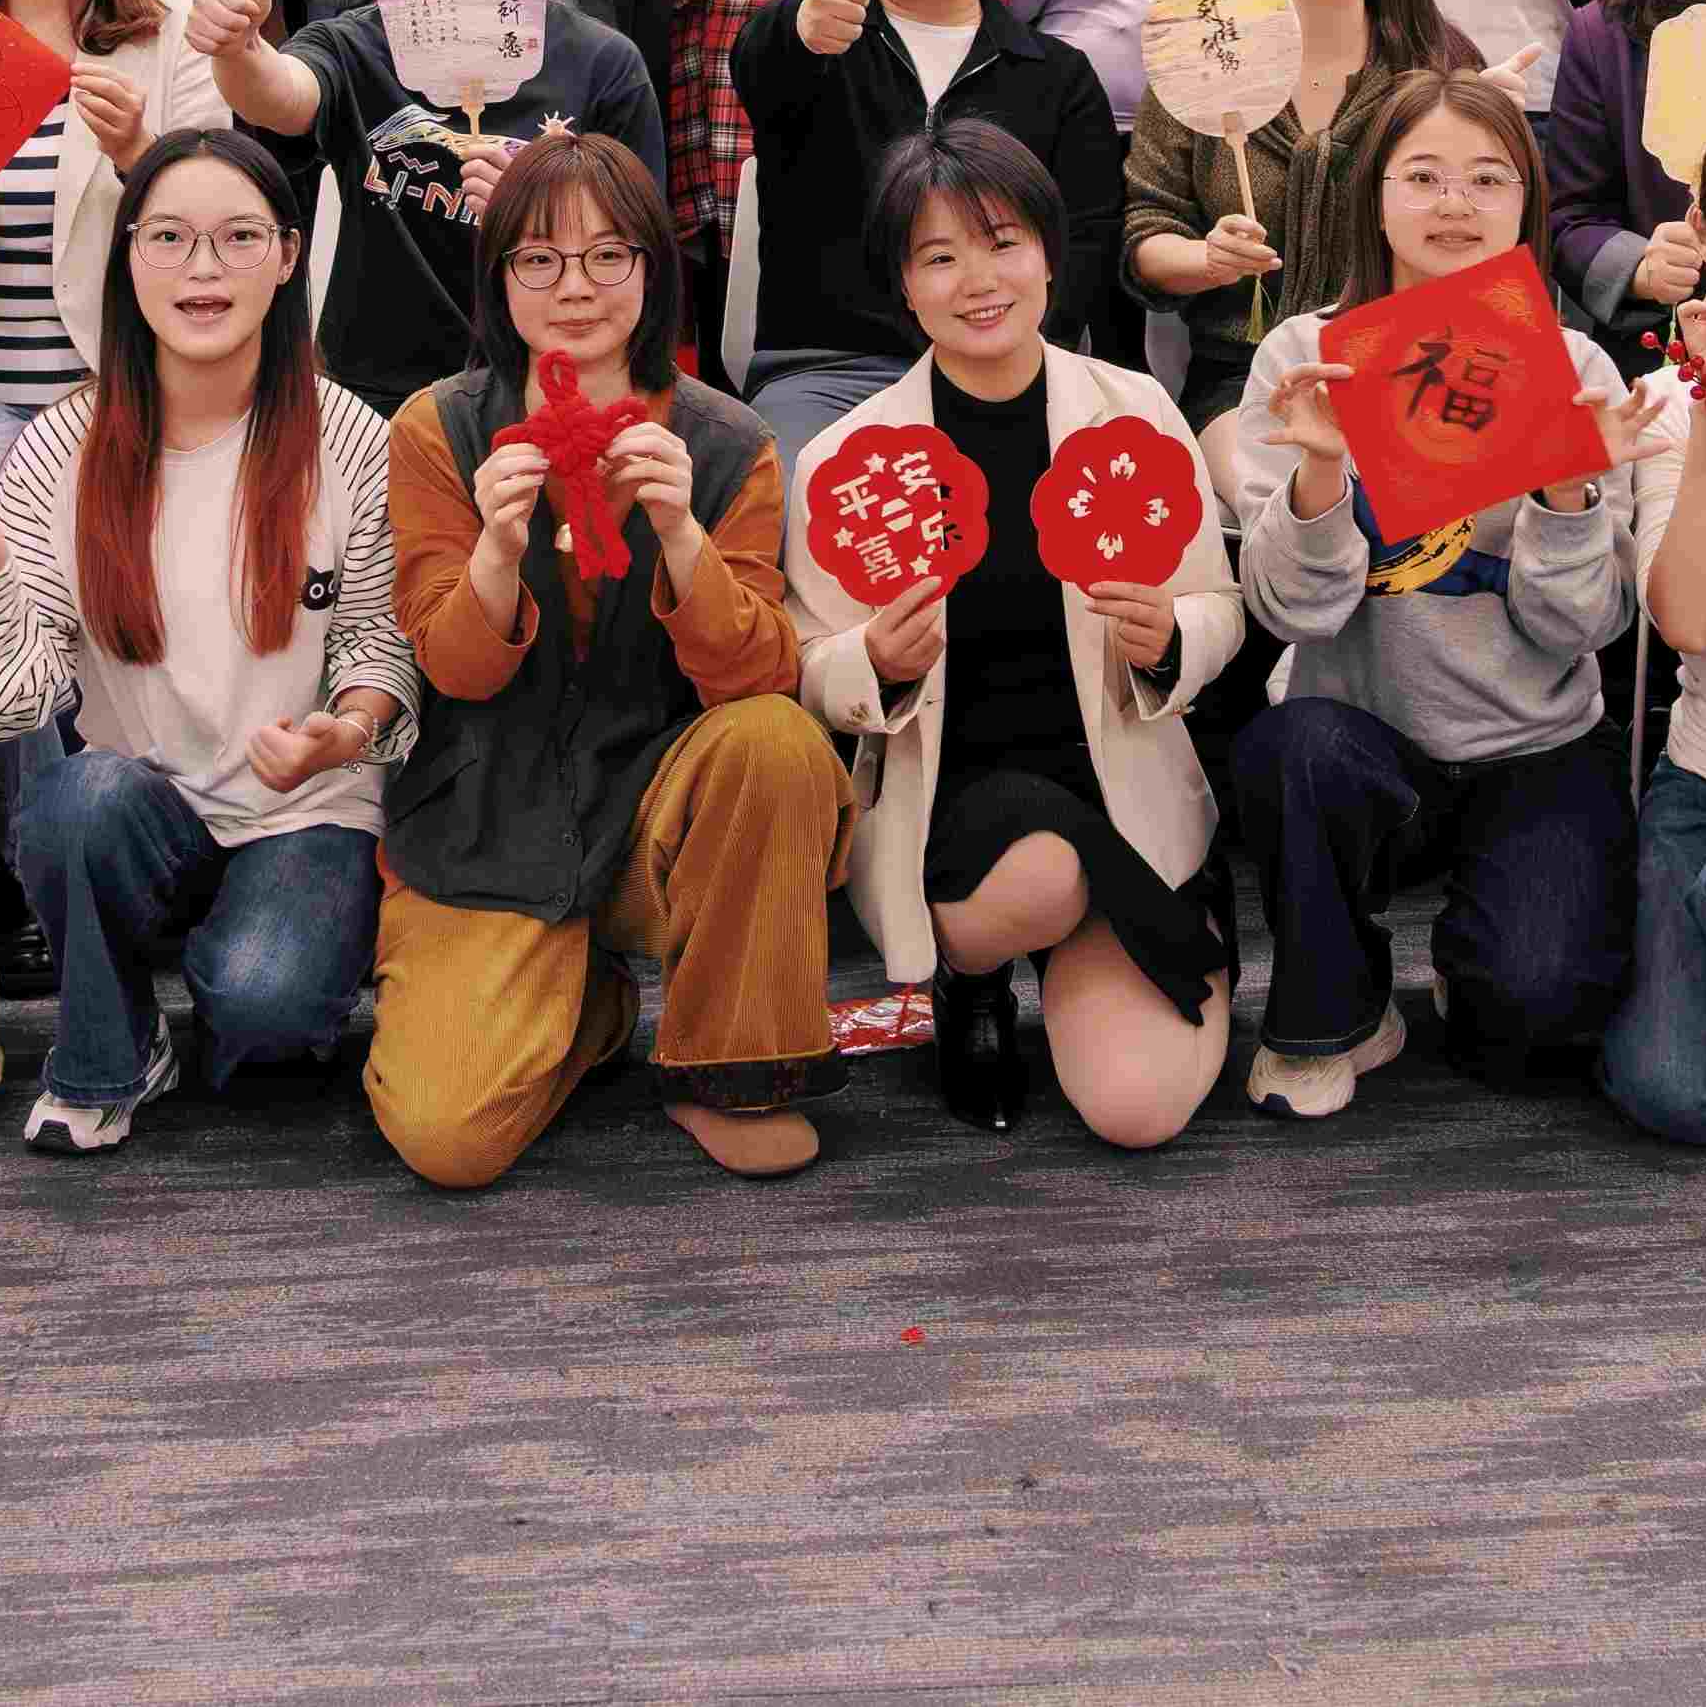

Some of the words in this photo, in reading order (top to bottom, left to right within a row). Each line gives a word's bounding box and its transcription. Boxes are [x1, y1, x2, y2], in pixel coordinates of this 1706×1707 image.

[1391, 325, 1510, 433] 福
[830, 450, 951, 520] 平安
[855, 509, 964, 585] 喜乐
